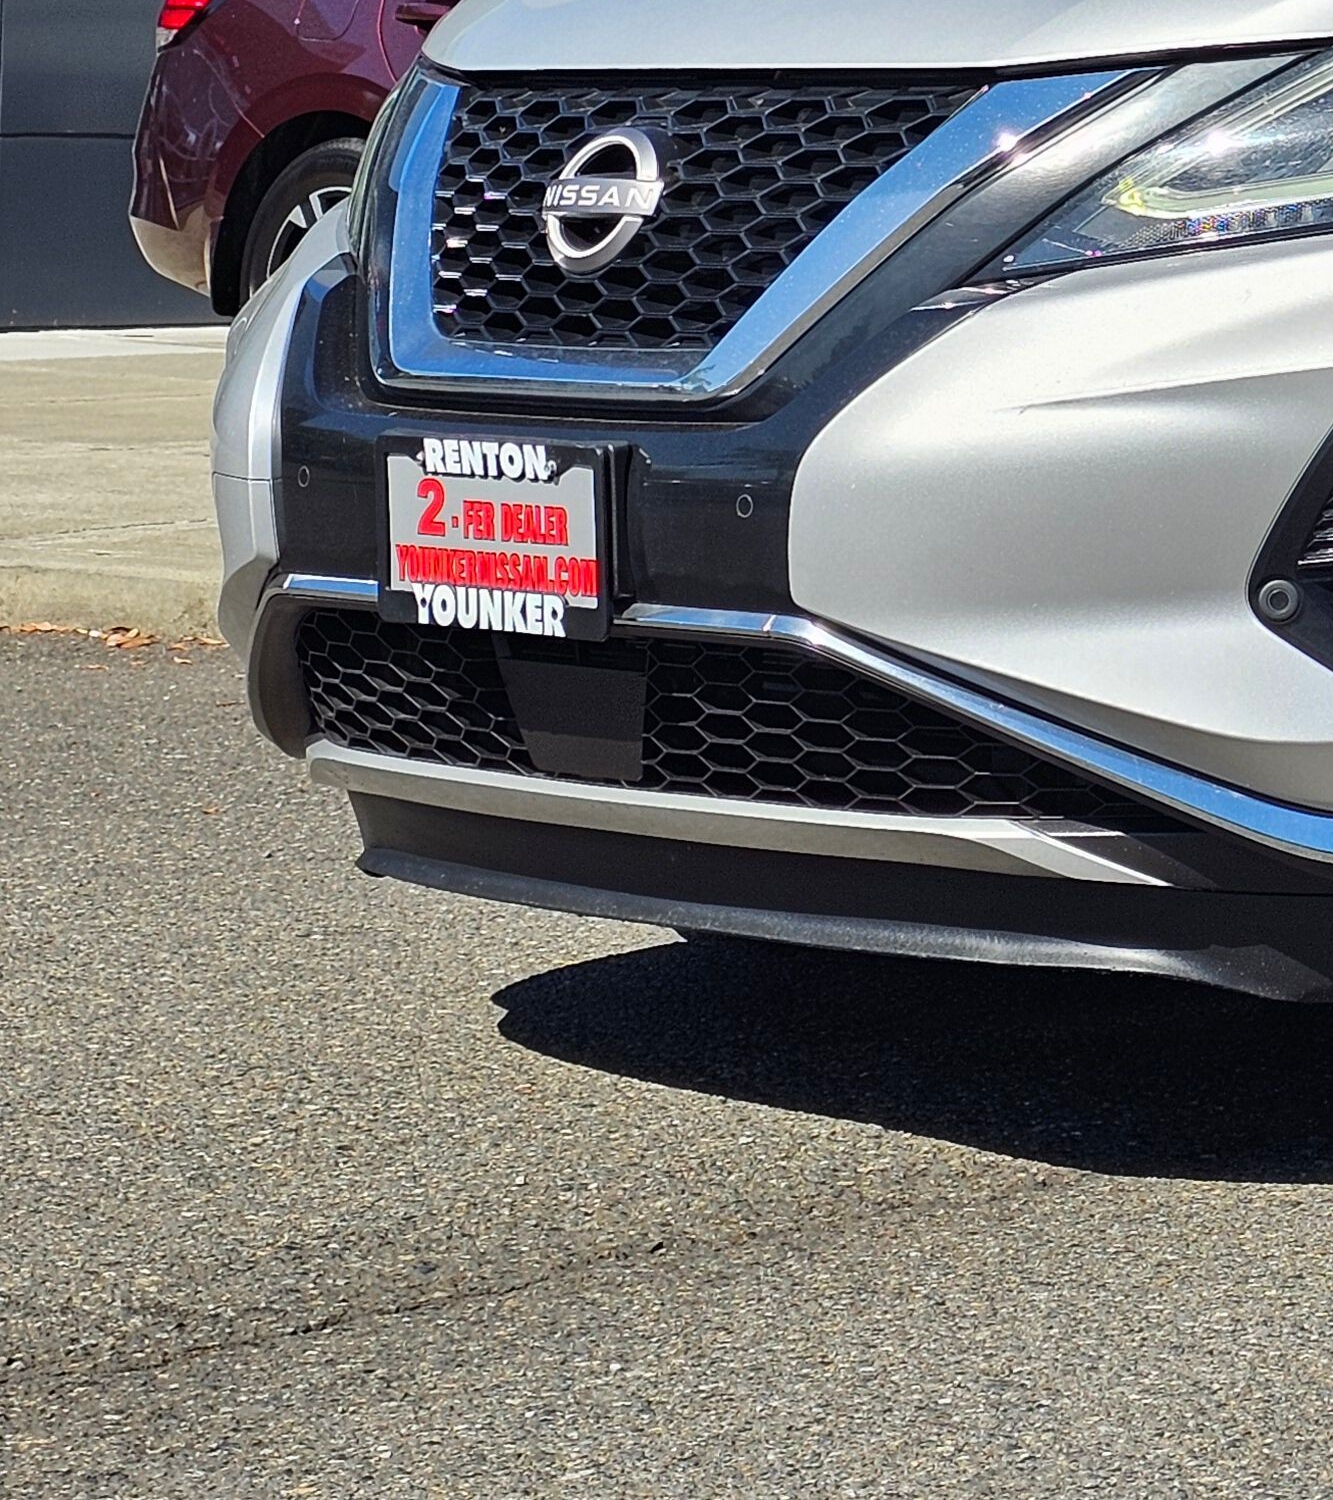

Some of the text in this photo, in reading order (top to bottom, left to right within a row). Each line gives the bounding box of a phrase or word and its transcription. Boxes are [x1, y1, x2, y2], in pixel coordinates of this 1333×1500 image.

[542, 185, 653, 210] NISSAN
[422, 437, 549, 481] RENTON
[501, 503, 569, 546] DEALER
[396, 543, 598, 597] YOUNKERNISSAN.COM
[411, 582, 567, 638] YOUNKER
